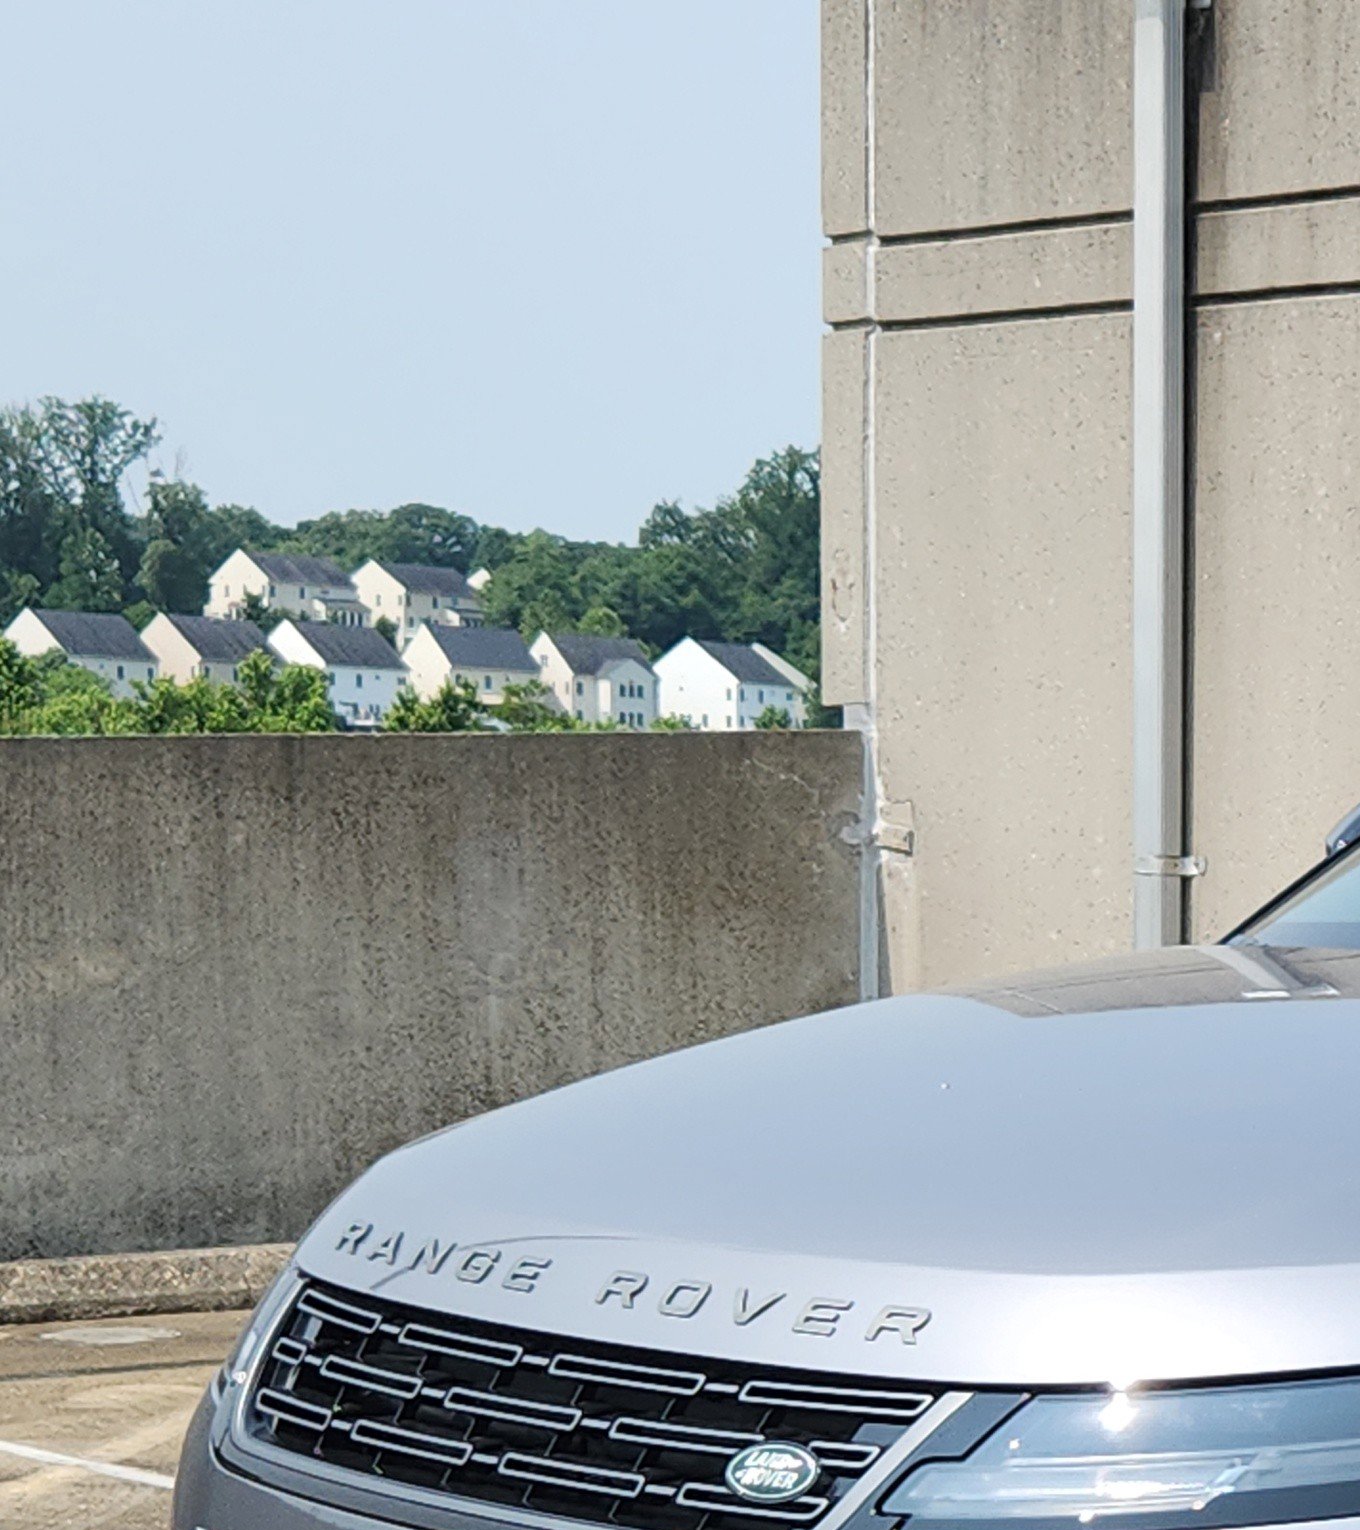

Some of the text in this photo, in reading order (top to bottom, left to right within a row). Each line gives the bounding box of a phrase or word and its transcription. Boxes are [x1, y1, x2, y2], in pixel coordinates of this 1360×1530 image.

[333, 1220, 933, 1346] RANGE ROVER
[740, 1466, 799, 1490] ROVER
